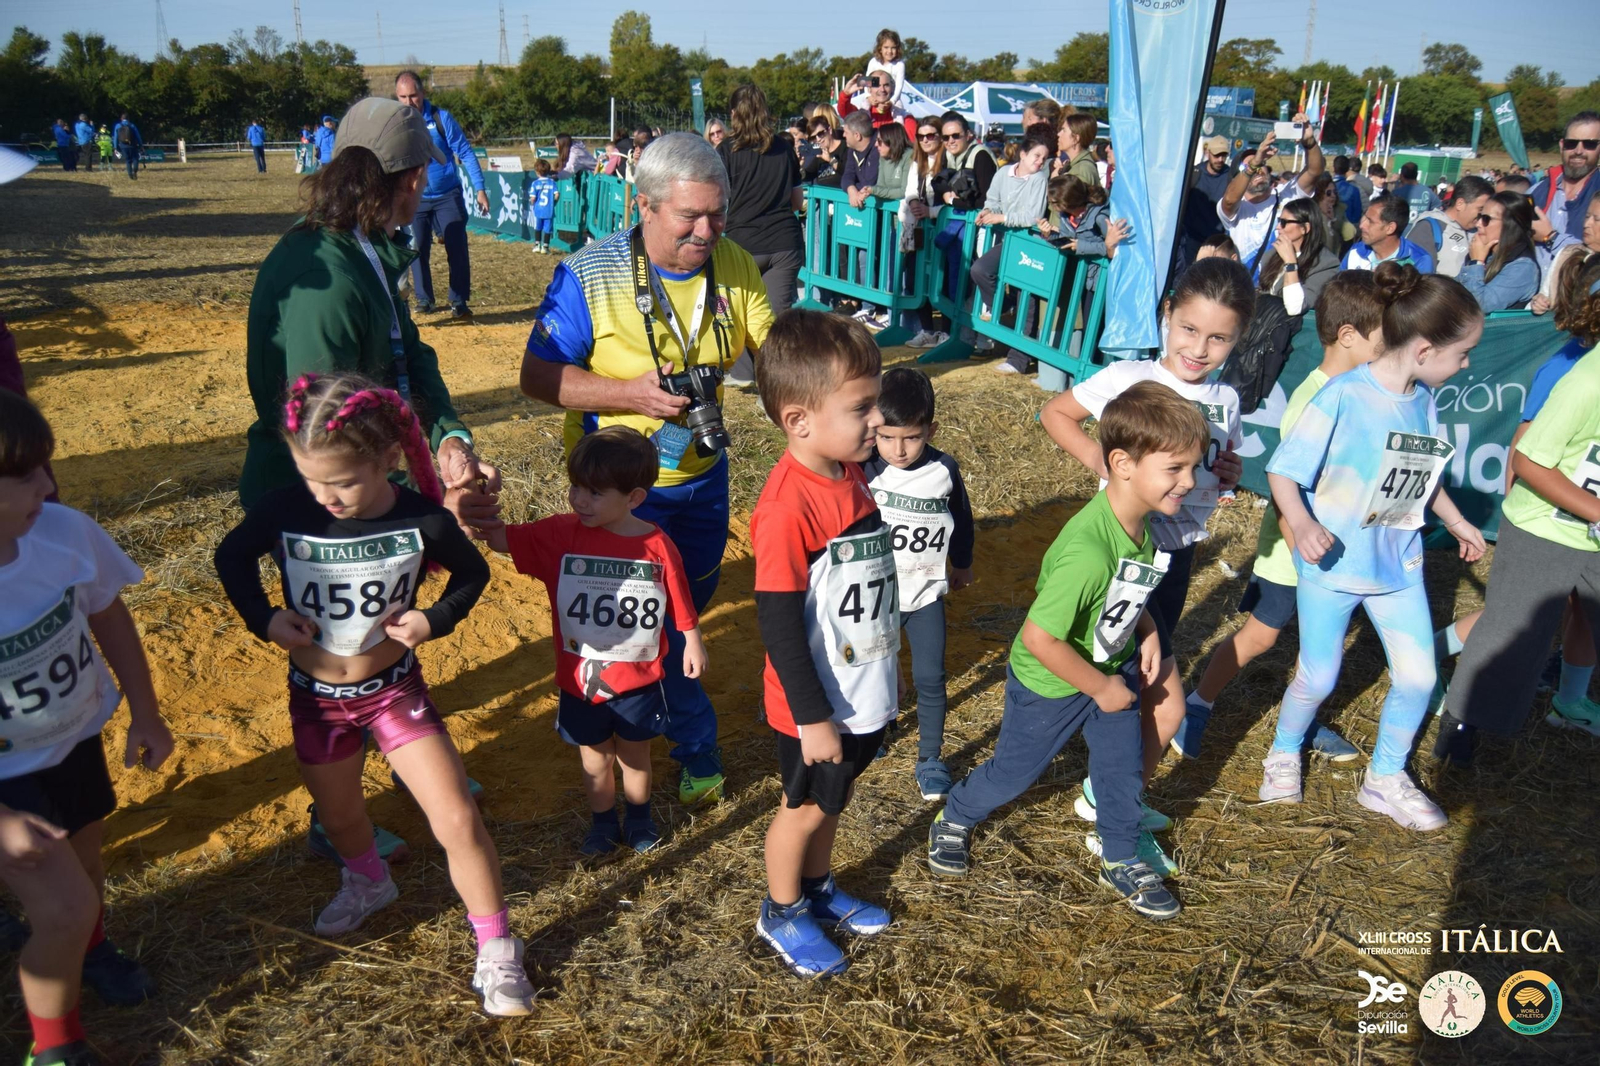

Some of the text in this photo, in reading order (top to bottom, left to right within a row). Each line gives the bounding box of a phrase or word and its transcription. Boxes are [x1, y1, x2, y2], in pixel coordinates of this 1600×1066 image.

[539, 189, 549, 206] 5
[637, 256, 647, 287] Nikon
[1433, 374, 1527, 413] ción
[1380, 467, 1432, 500] 4778
[894, 496, 937, 511] ITÁLICA
[320, 542, 387, 560] ITÁLICA
[863, 535, 893, 556] ITÁLIC
[890, 524, 946, 553] 684
[593, 562, 646, 578] ITÁLICA
[301, 572, 411, 621] 4584
[566, 593, 660, 630] 4688
[838, 573, 900, 623] 477
[0, 614, 63, 657] TÁLICA
[314, 678, 384, 698] PRO
